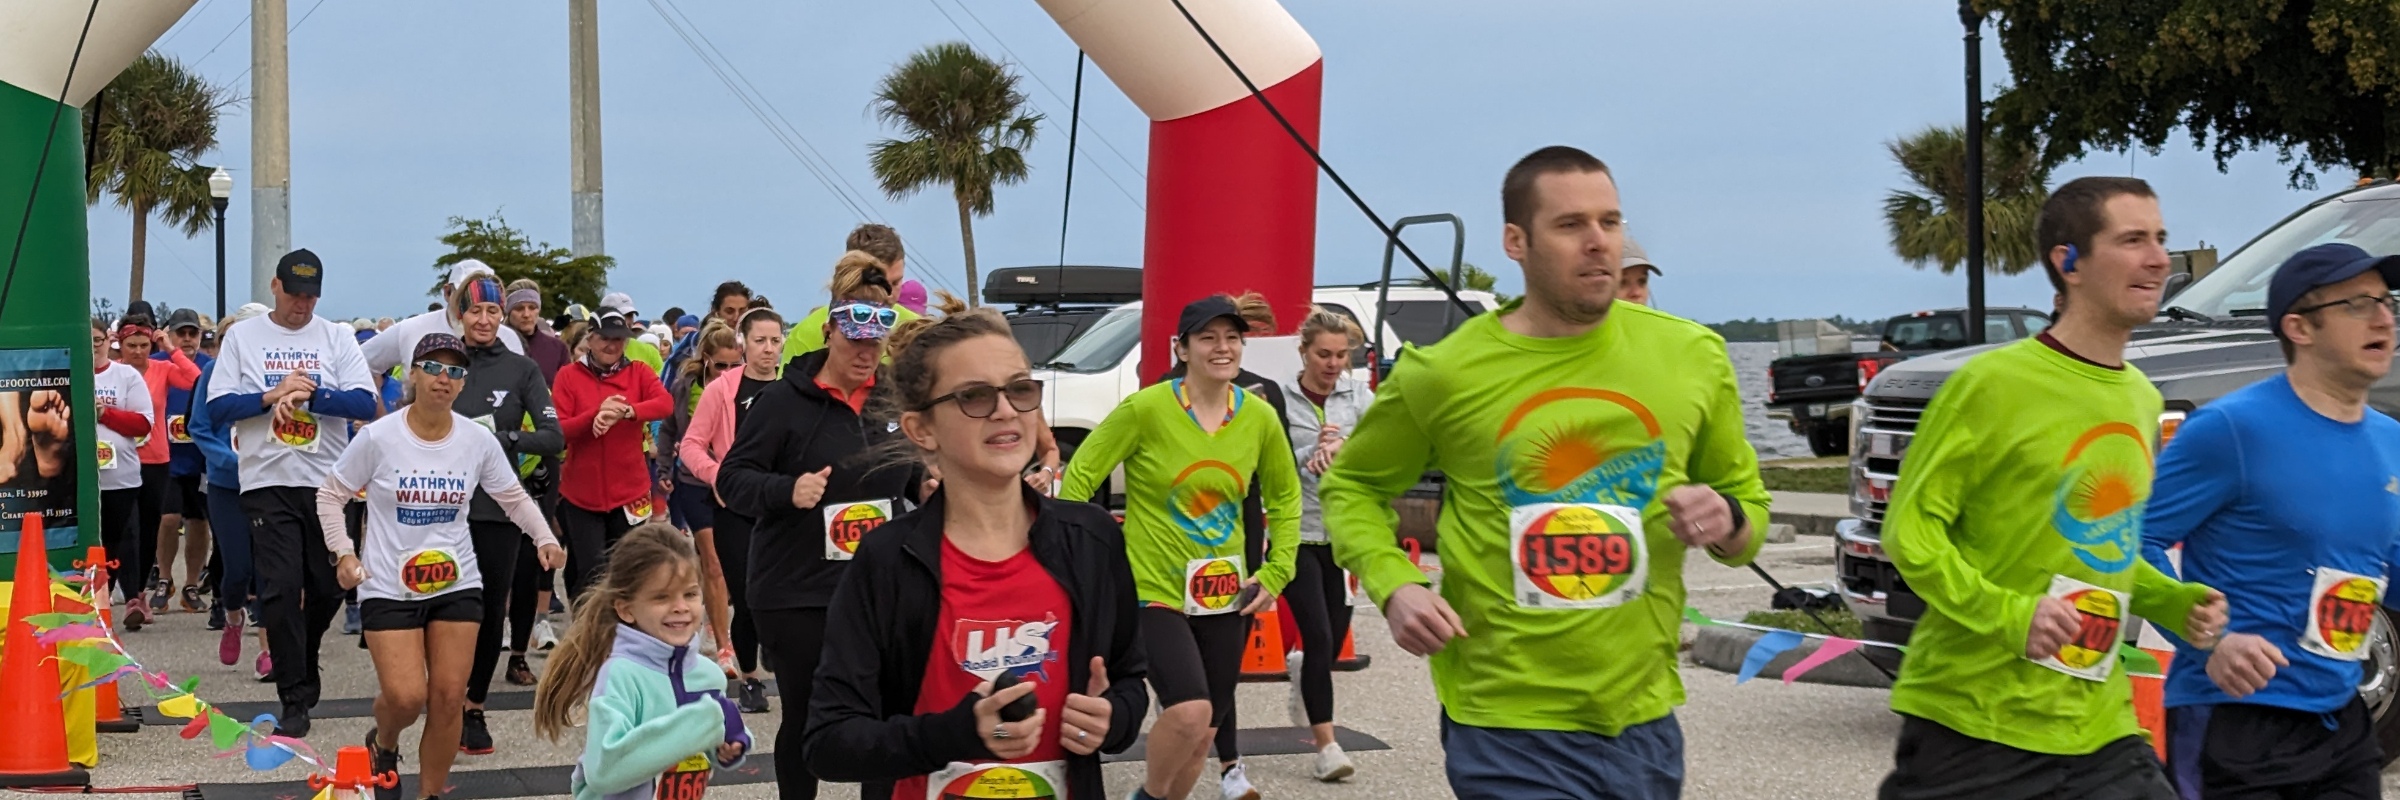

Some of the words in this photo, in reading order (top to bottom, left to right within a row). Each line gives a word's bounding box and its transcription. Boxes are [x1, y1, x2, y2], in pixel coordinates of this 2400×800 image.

[264, 361, 320, 370] WALLACE
[266, 352, 318, 360] KATHRYN
[399, 477, 465, 491] KATHRYN
[396, 490, 466, 504] WALLACE
[1528, 535, 1631, 575] 1589
[407, 563, 456, 585] 1702
[1195, 574, 1239, 597] 1708
[966, 621, 1050, 663] US
[2070, 612, 2120, 653] 707
[963, 659, 998, 670] Road
[664, 771, 710, 800] 166
